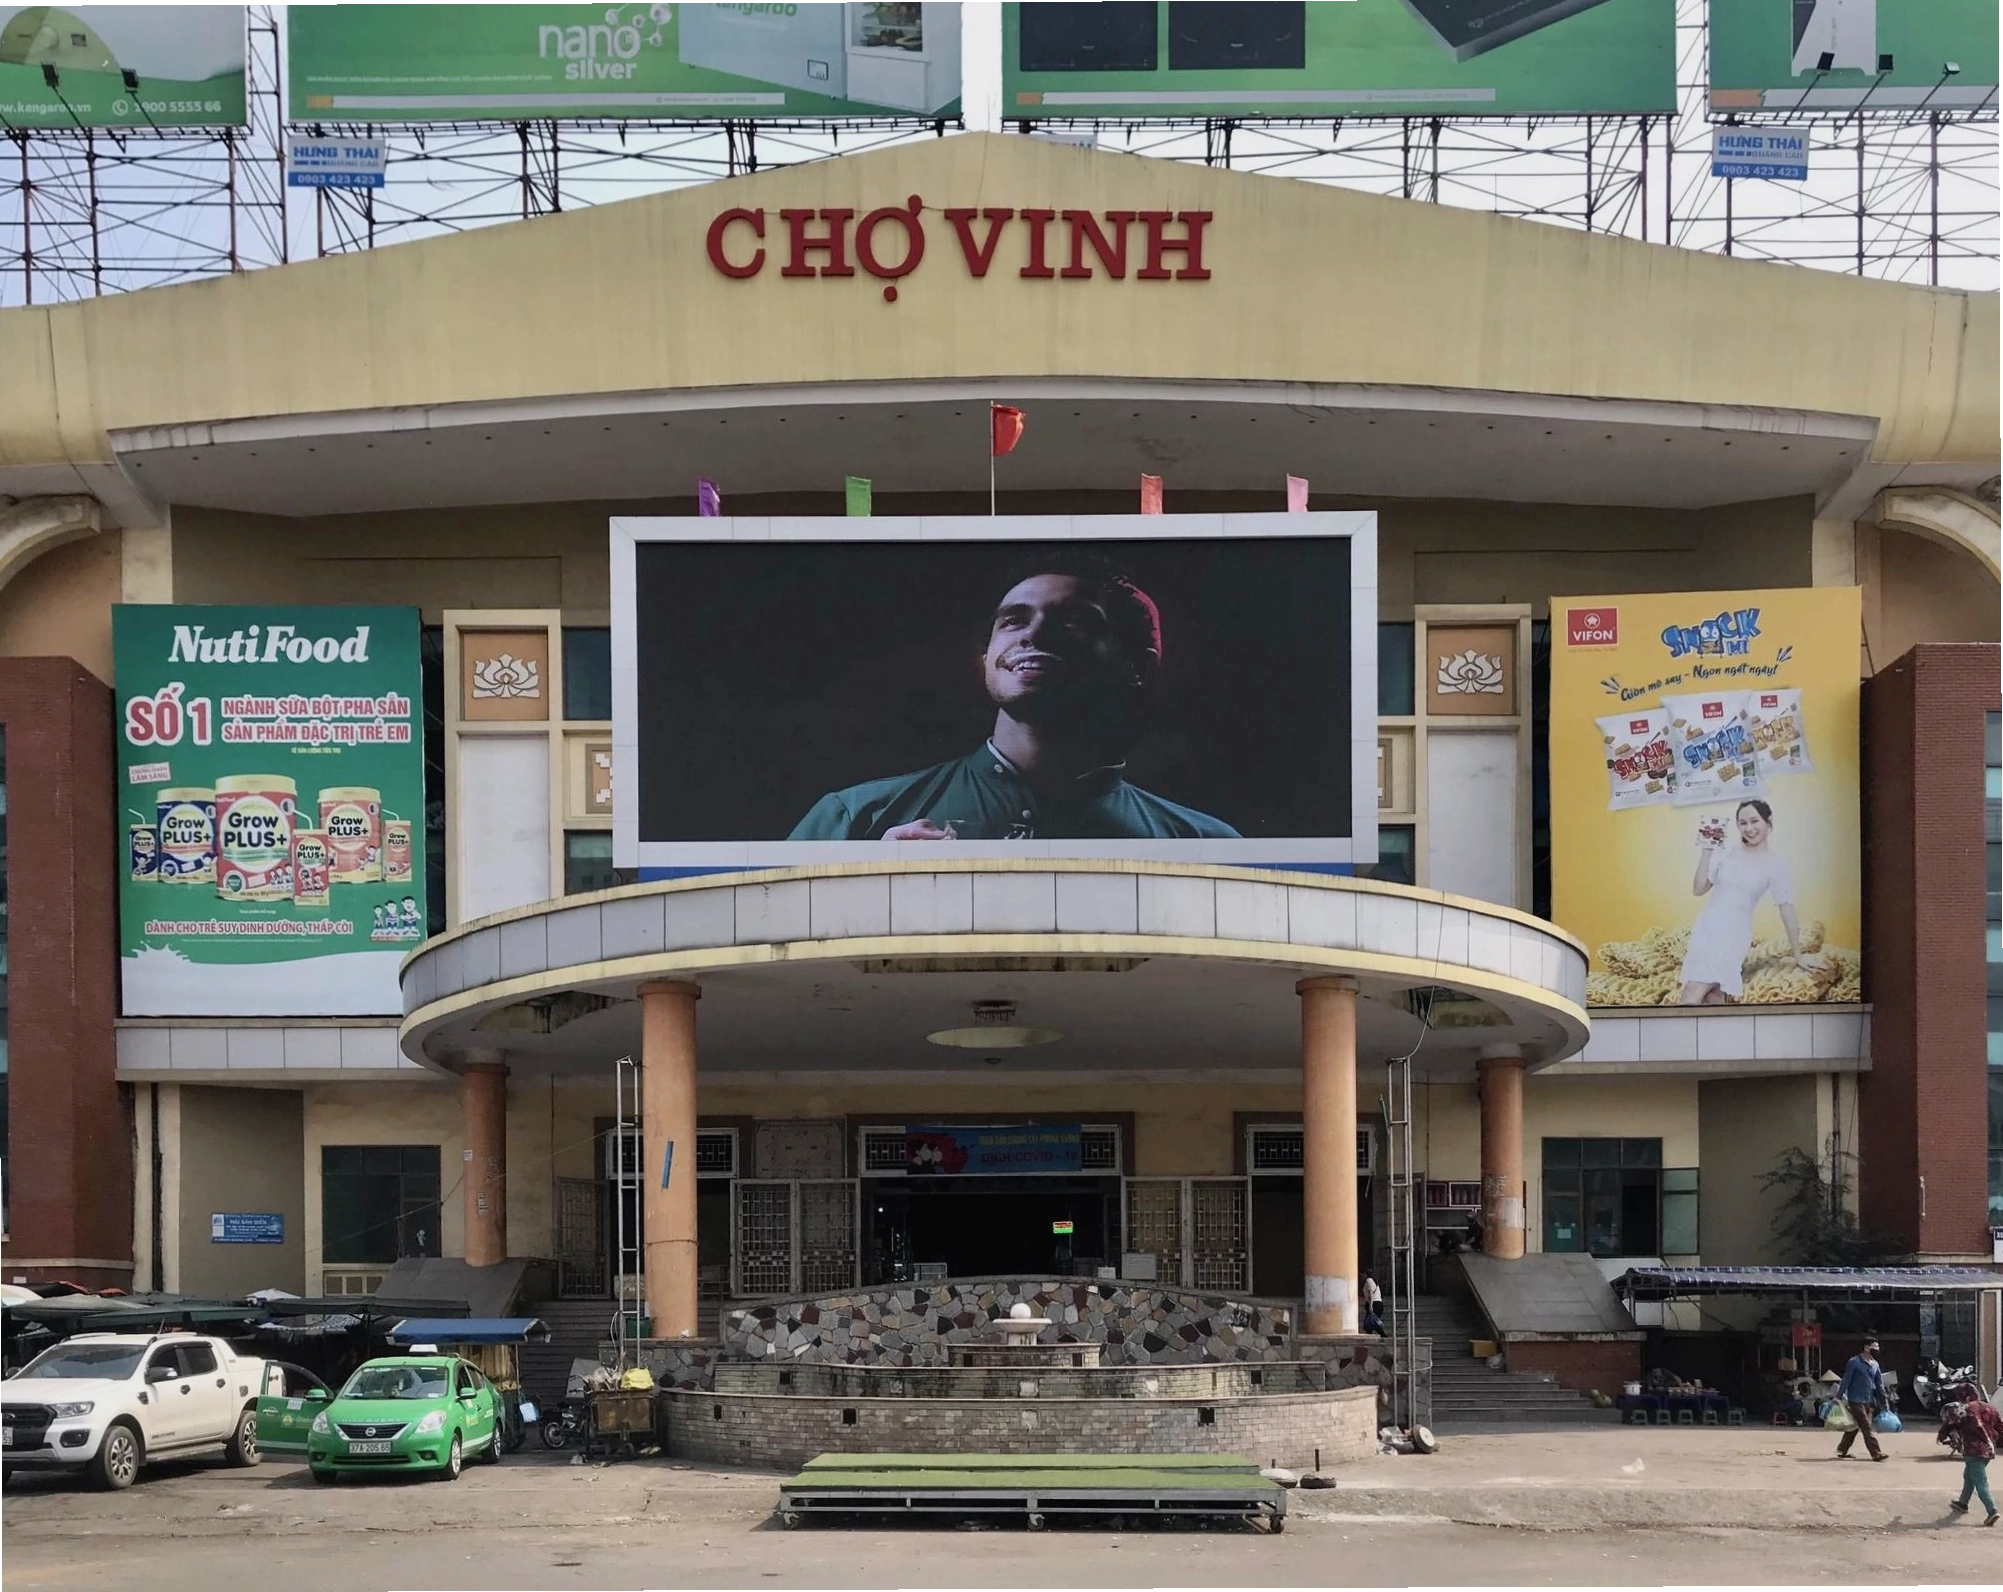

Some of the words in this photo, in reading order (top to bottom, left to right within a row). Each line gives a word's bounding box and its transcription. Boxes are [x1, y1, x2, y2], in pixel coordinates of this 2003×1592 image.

[538, 24, 641, 60] nano
[564, 58, 638, 80] silver
[169, 101, 202, 112] 5555
[204, 101, 221, 112] 66
[1767, 135, 1803, 150] THÁI
[1722, 165, 1750, 175] 0903
[1753, 166, 1775, 176] 423
[1778, 167, 1799, 177] 423
[297, 174, 326, 184] 0903
[329, 174, 351, 184] 423
[354, 175, 376, 185] 423
[706, 194, 925, 302] CHỢ
[943, 206, 1213, 280] VINH
[1572, 630, 1613, 641] VIFON
[167, 624, 371, 663] NutiFood
[1664, 674, 1682, 685] say
[1693, 664, 1722, 680] Ngon
[128, 684, 182, 744] SỐ
[189, 699, 209, 744] 1
[223, 695, 276, 716] NGÀNH
[278, 695, 308, 716] SỮA
[311, 696, 340, 719] BỘT
[343, 699, 374, 716] PHA
[223, 720, 253, 741] SẢN
[256, 718, 298, 741] PHẨM
[301, 720, 330, 744] ĐẶC
[332, 725, 355, 744] TRỊ
[357, 719, 384, 741] TRẺ
[386, 725, 409, 741] EM
[166, 816, 205, 829] Grow
[228, 812, 279, 828] Grow
[331, 815, 363, 826] Grow
[163, 831, 211, 844] PLUS+
[328, 827, 369, 836] PLUS+
[223, 831, 287, 848] PLUS+
[146, 919, 175, 934] DÀNH
[176, 922, 197, 934] CHO
[198, 919, 217, 934] TRẺ
[218, 922, 238, 934] SUY
[239, 922, 264, 934] DINH
[334, 919, 352, 934] CÒI
